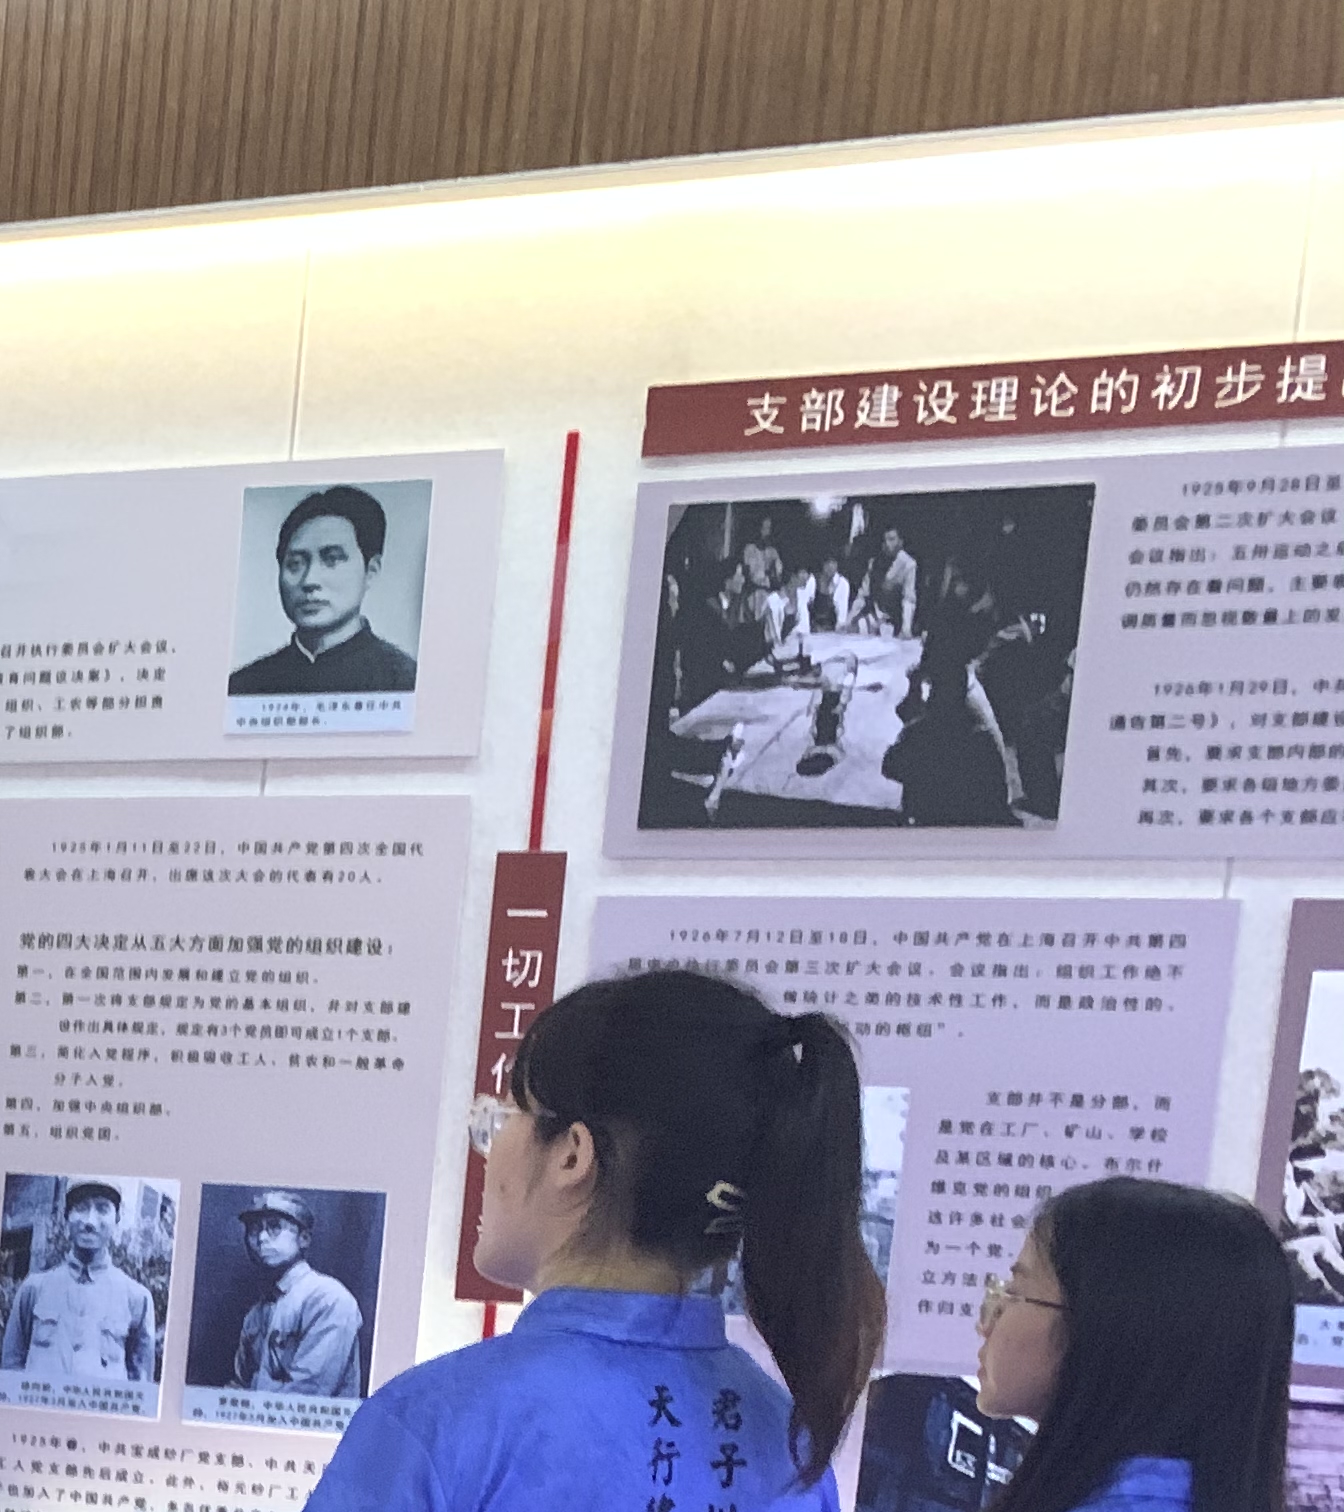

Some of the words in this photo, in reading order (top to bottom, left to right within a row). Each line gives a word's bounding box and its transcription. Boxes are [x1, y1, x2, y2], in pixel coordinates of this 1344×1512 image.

[743, 354, 1344, 436] 支部建设理论的初步提
[1142, 775, 1344, 793] 其次，要求各级地方委
[1138, 807, 1344, 825] 再次，要求各个支部应
